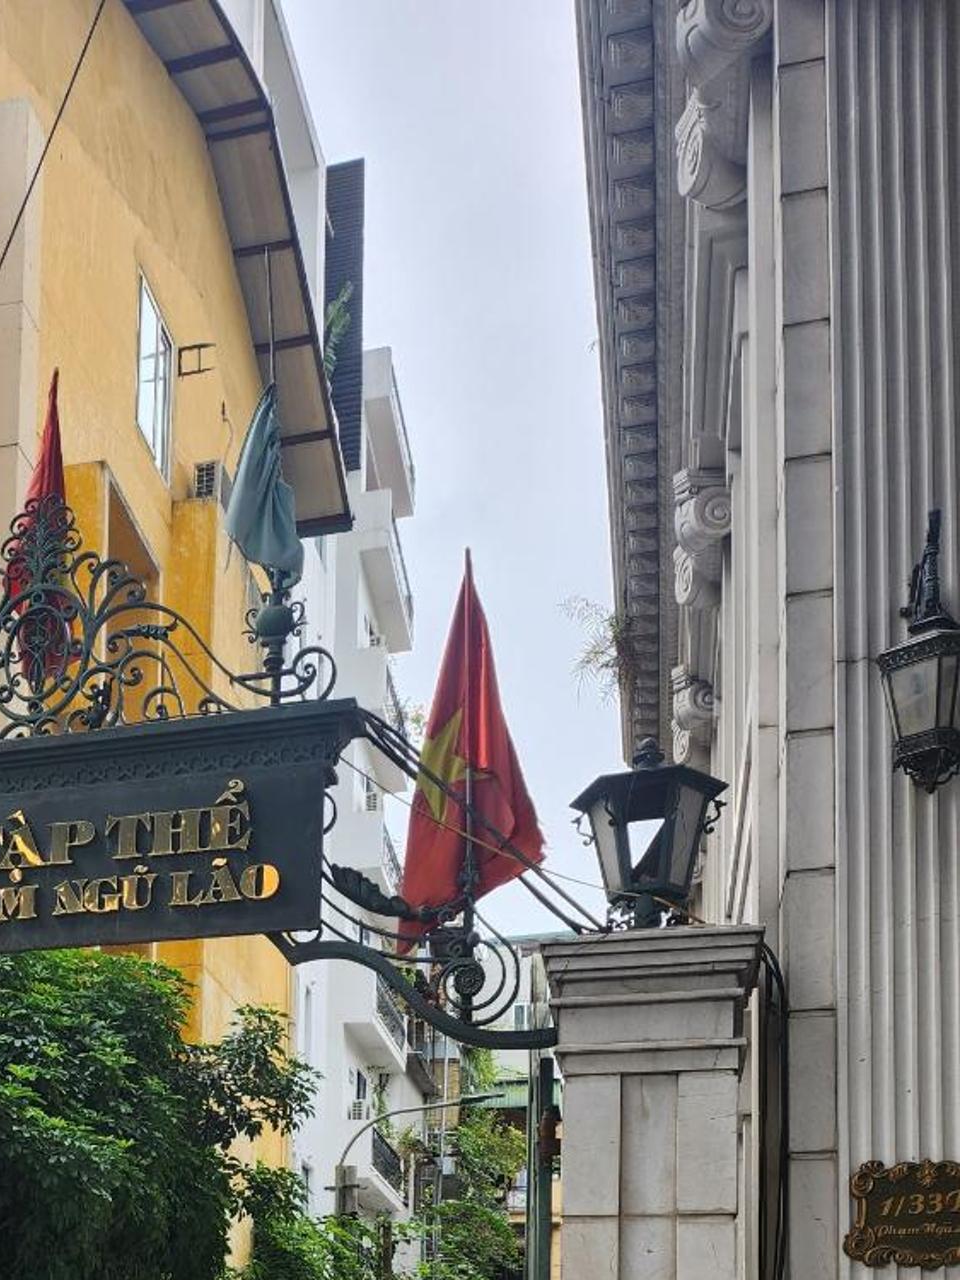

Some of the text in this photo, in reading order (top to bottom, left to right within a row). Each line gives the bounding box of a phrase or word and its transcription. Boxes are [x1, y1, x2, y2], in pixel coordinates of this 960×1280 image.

[104, 778, 254, 860] THỂ
[51, 864, 158, 916] NGŨ
[167, 856, 281, 909] LÃO
